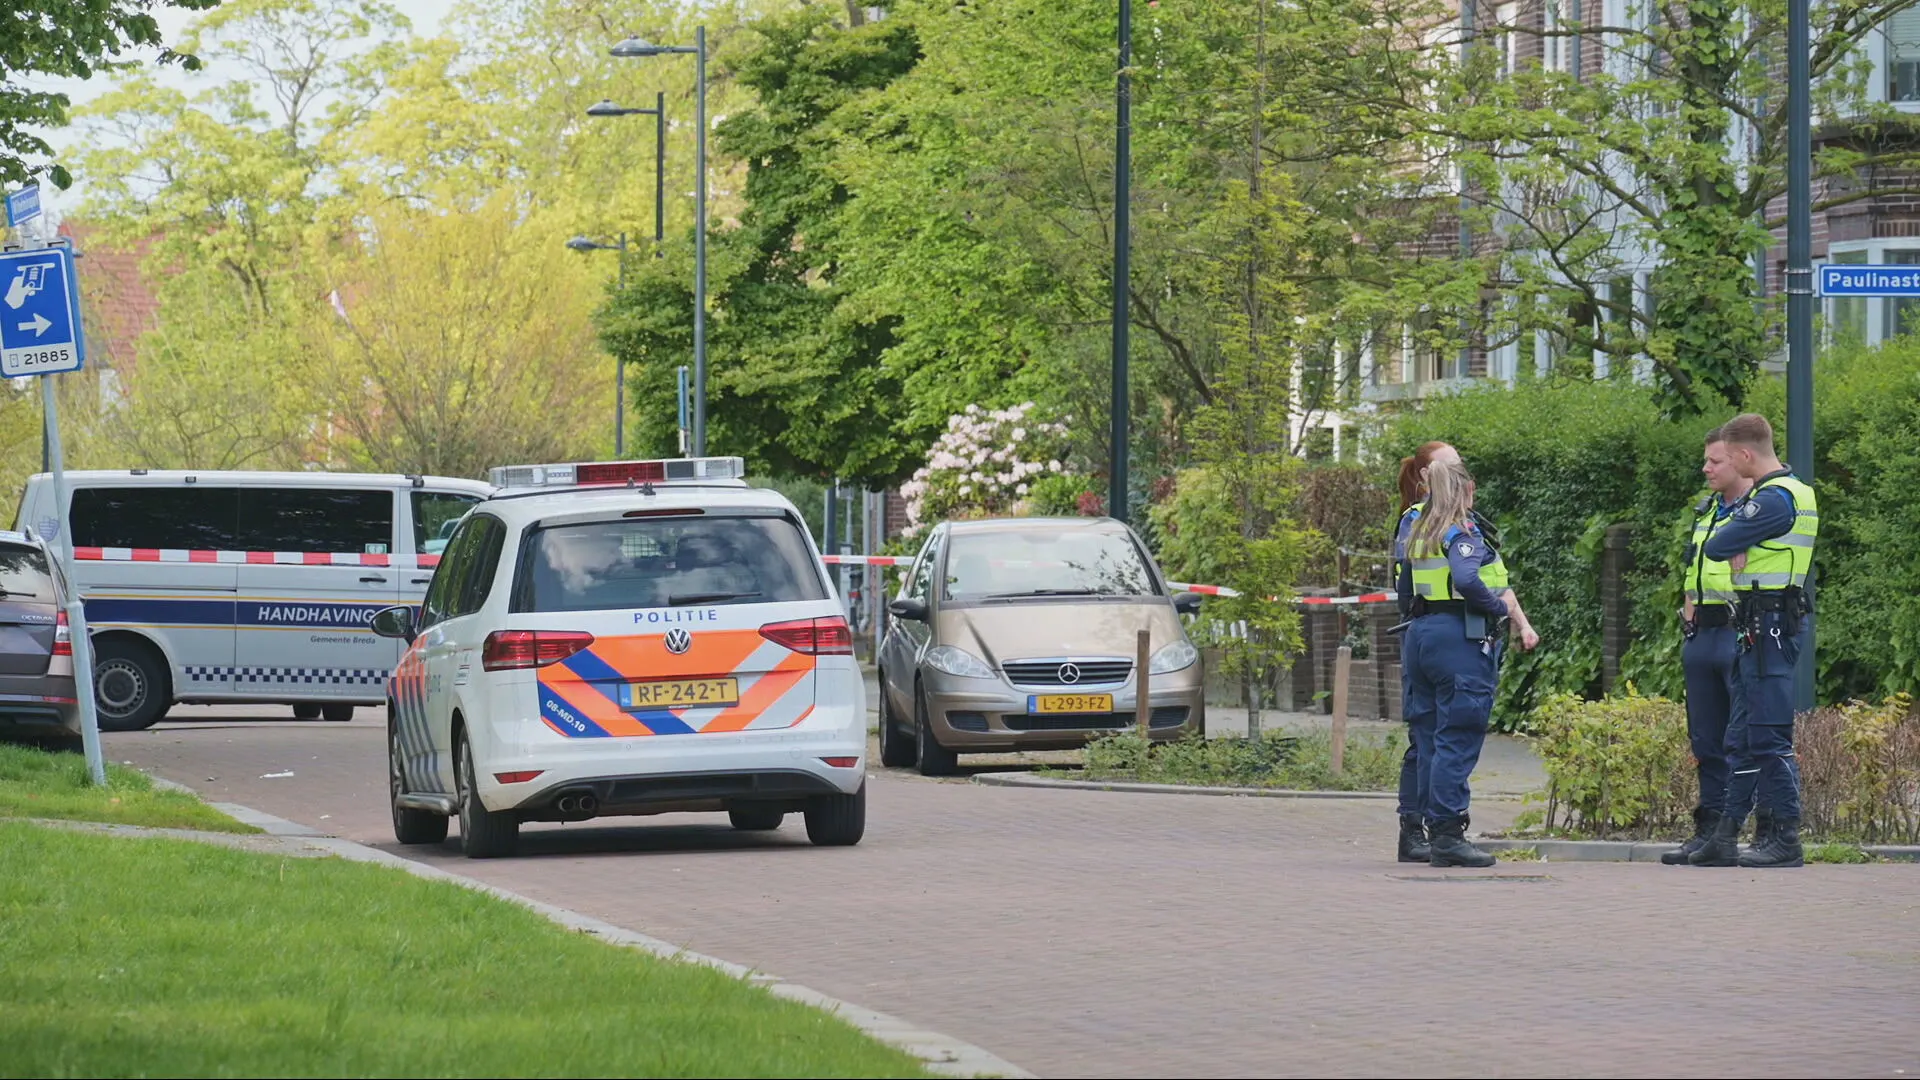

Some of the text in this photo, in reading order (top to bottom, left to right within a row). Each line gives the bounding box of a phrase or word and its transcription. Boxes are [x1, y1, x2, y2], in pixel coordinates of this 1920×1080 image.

[1828, 272, 1920, 288] Paulinast
[23, 349, 70, 366] 21885
[258, 606, 376, 624] HANDHAVING
[633, 609, 717, 624] POLITIE
[310, 635, 376, 645] Gemeente Breda
[638, 682, 728, 703] RF-242-T
[1043, 696, 1105, 710] L-293-FZ
[546, 700, 586, 732] 08-MD.10
